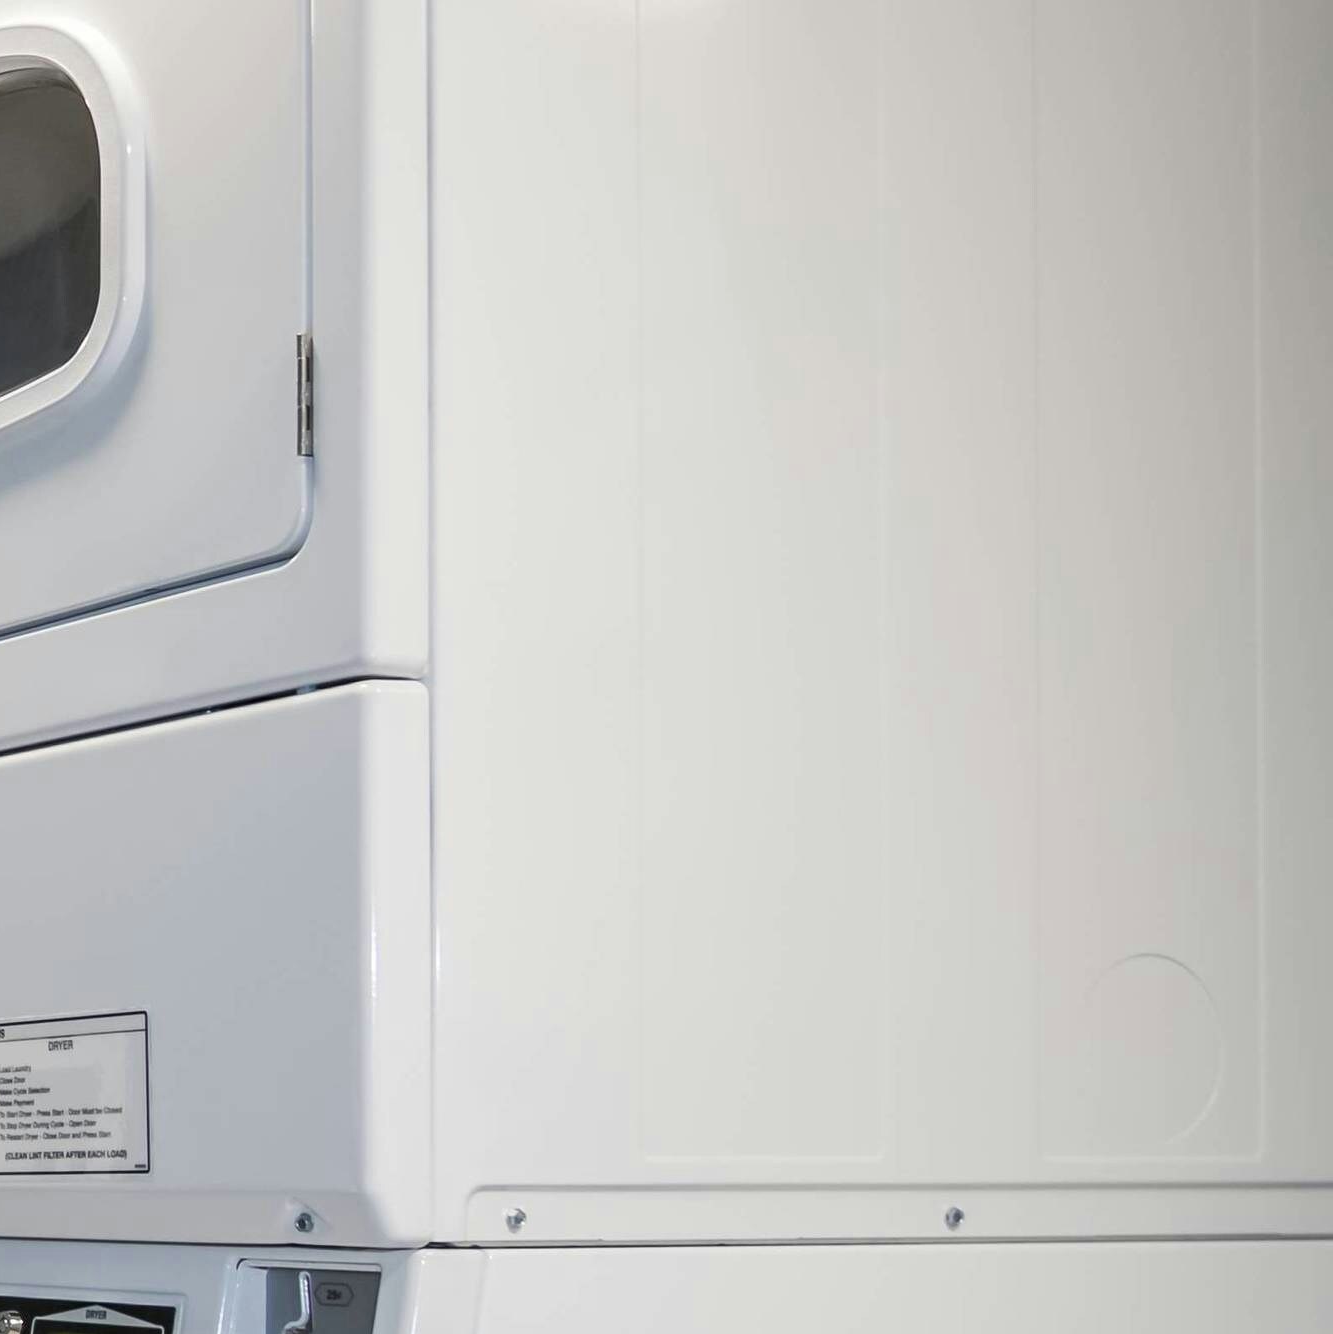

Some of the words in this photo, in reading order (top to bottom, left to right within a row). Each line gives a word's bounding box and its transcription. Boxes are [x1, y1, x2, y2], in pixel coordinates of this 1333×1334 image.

[48, 1040, 73, 1051] DRYER
[88, 1150, 105, 1159] EACH
[85, 1309, 107, 1320] DRYER
